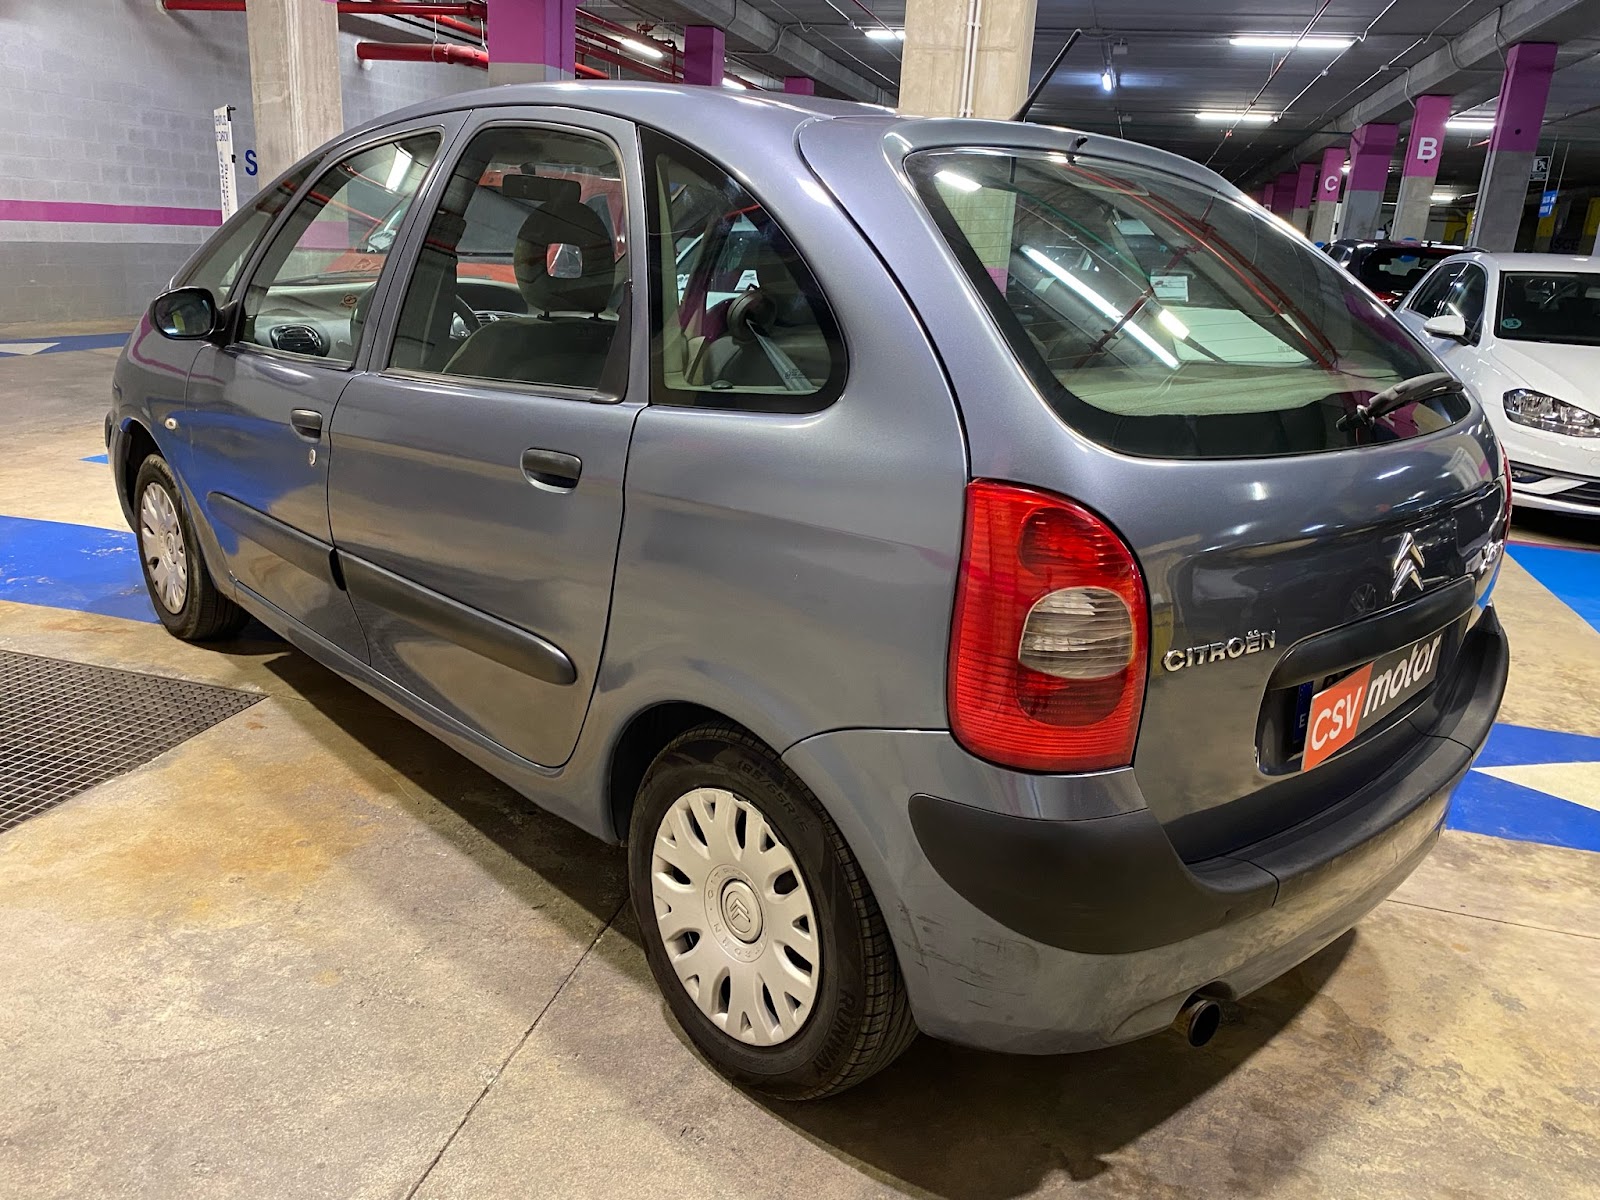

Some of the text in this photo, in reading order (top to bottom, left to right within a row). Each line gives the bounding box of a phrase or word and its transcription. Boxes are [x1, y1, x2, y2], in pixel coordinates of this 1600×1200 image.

[1416, 136, 1438, 160] B
[1324, 175, 1338, 191] C
[1163, 629, 1277, 673] CITROËN
[1311, 634, 1443, 751] CSV motor
